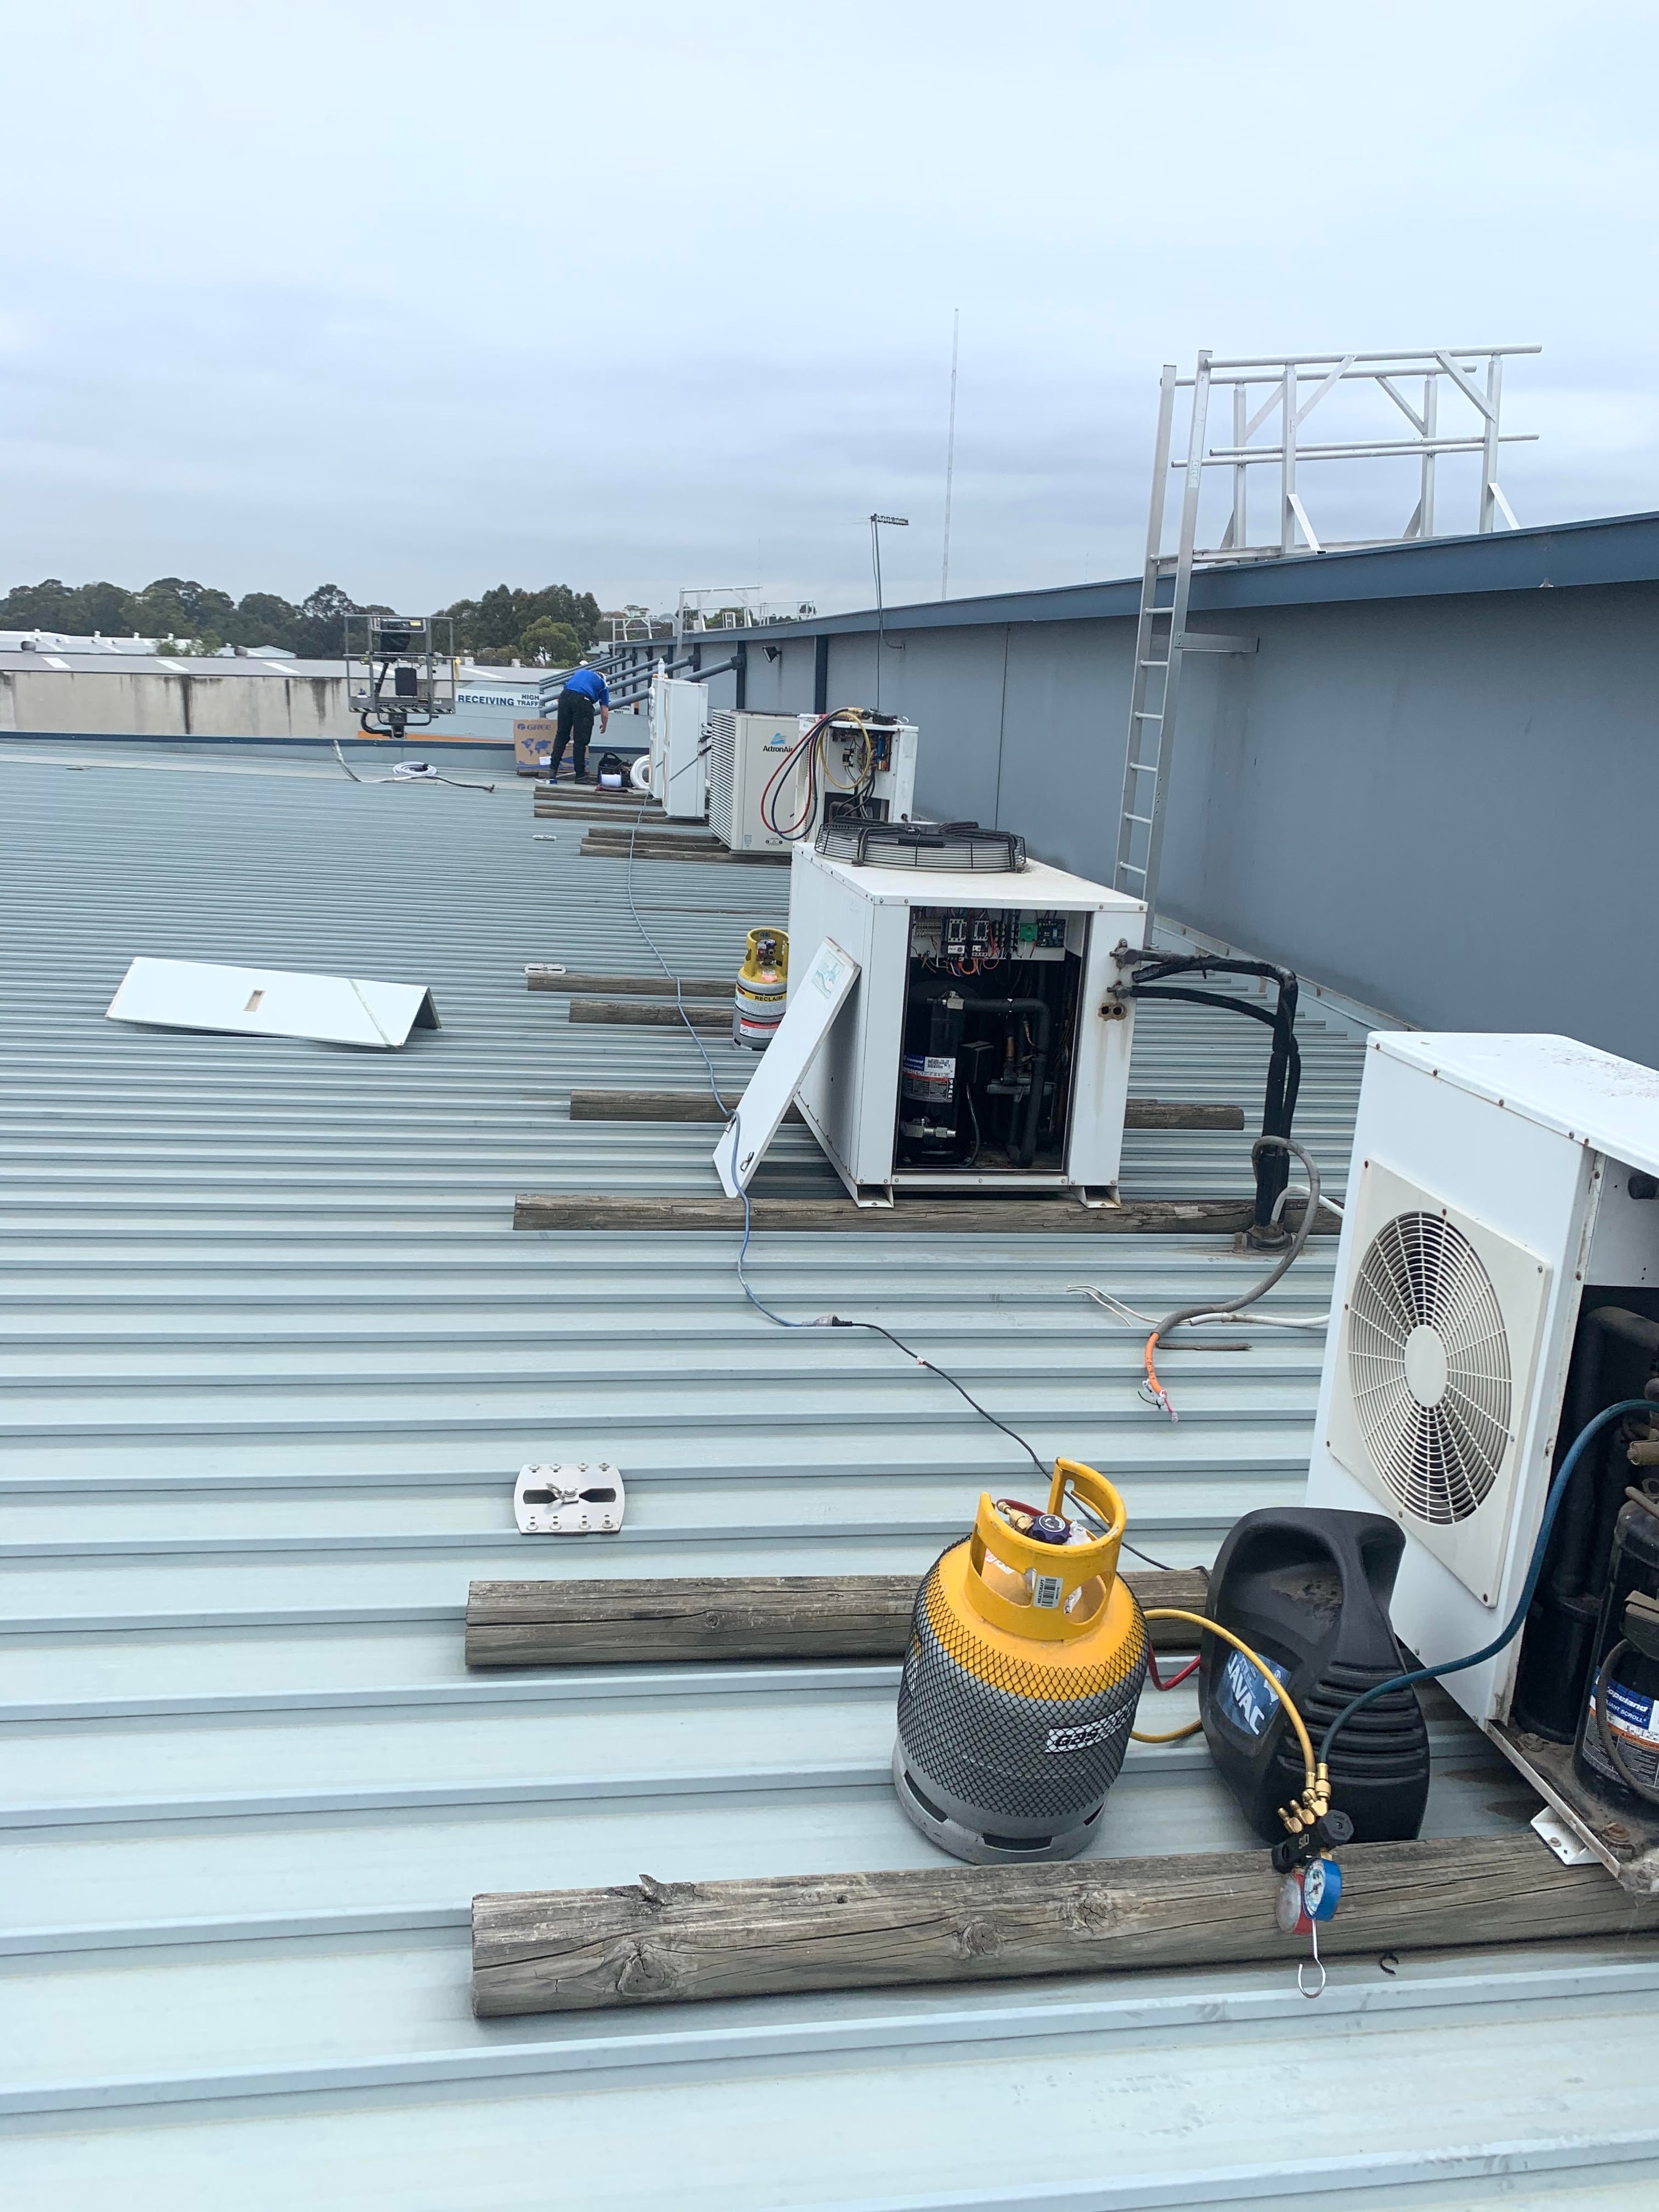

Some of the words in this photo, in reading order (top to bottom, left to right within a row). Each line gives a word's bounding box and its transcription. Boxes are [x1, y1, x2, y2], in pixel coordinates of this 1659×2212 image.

[458, 695, 514, 706] RECEIVING
[1228, 1653, 1265, 1736] JAVAC
[1606, 1686, 1648, 1712] opeland
[1620, 1707, 1643, 1723] SCROLL
